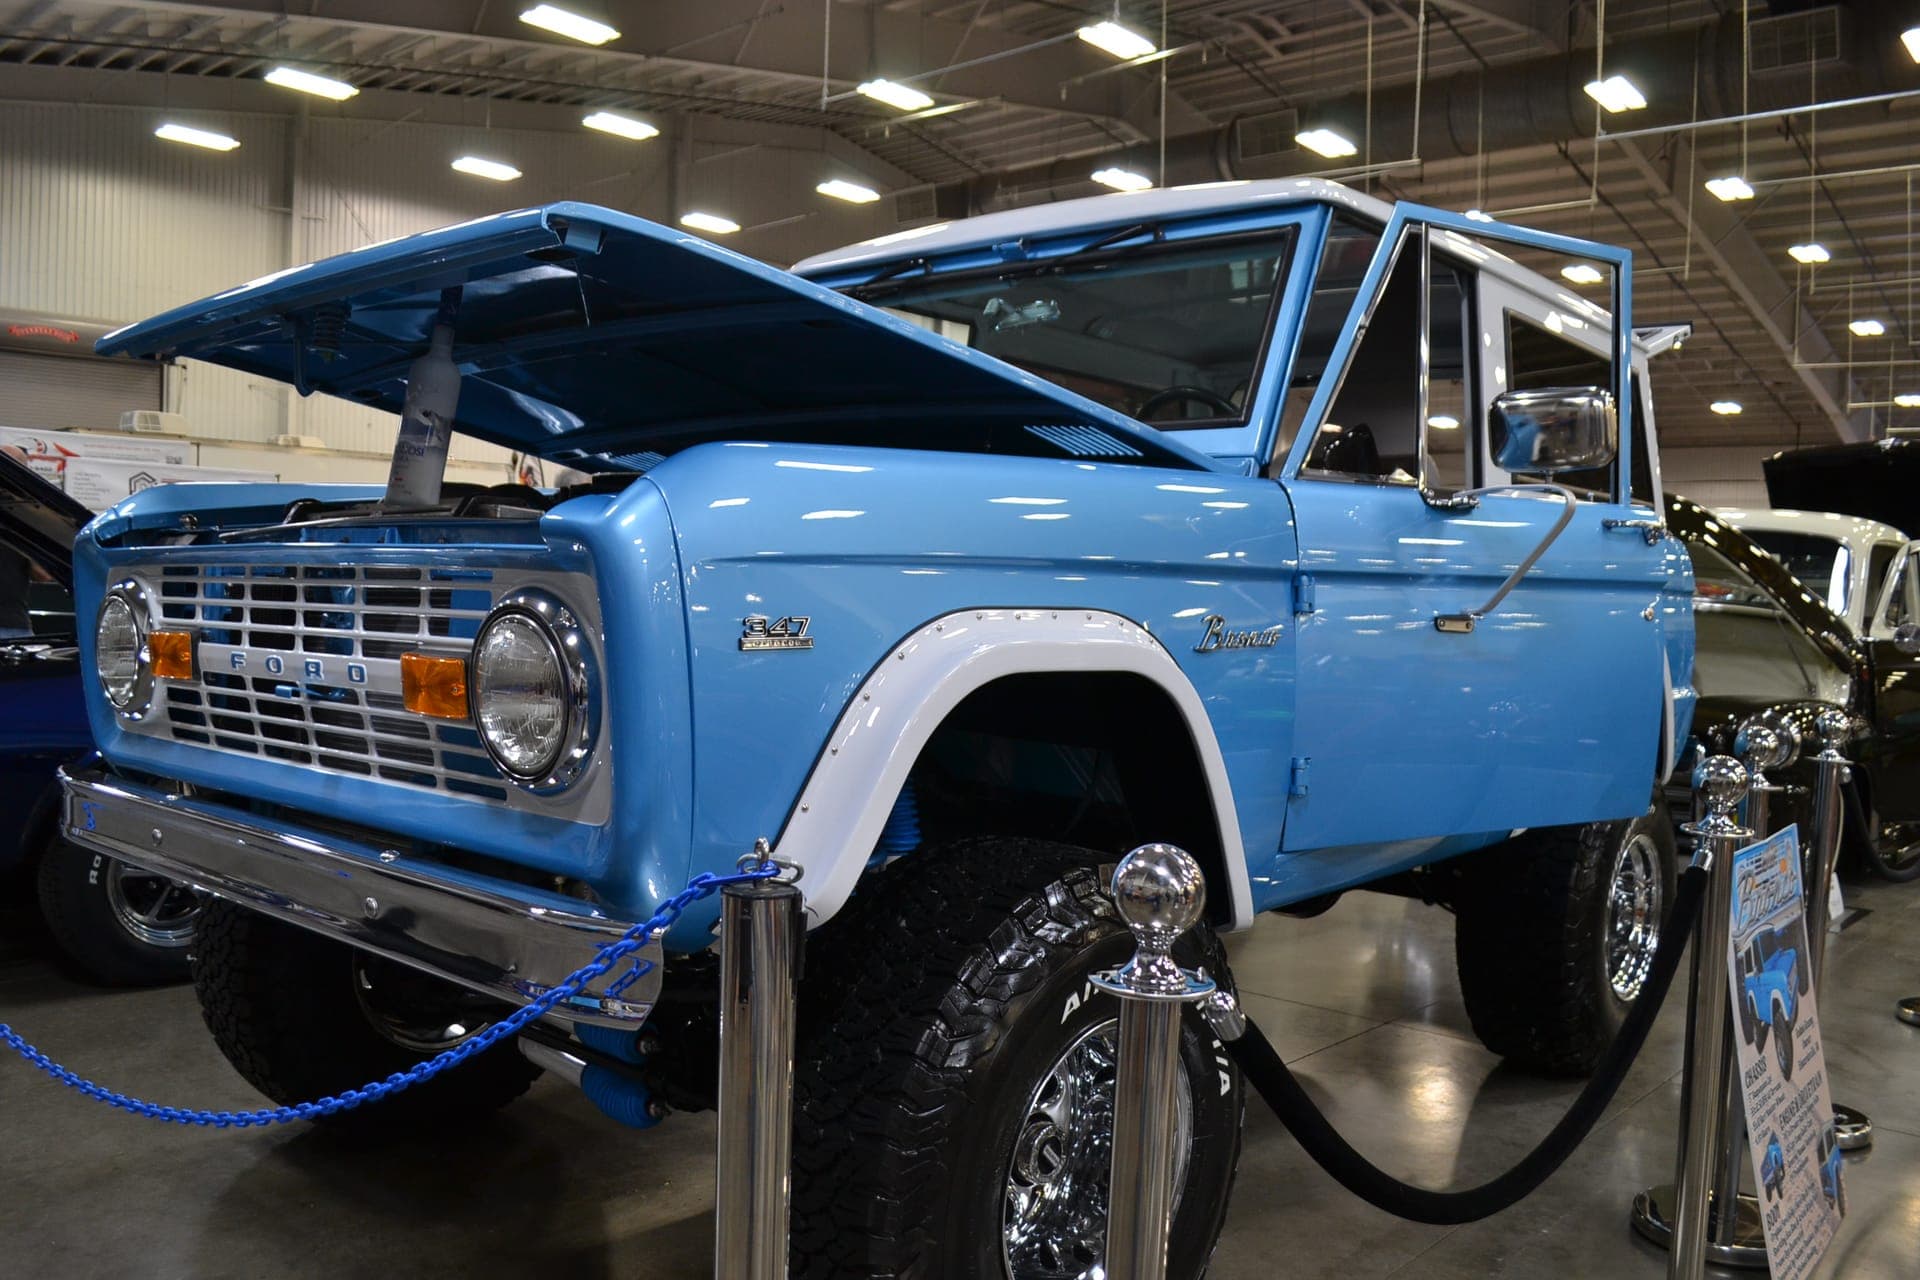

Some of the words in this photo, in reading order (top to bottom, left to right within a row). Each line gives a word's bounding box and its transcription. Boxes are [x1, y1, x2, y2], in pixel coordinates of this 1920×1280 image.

[743, 616, 811, 638] 347
[1193, 614, 1283, 653] Bronco
[230, 651, 368, 685] FORD
